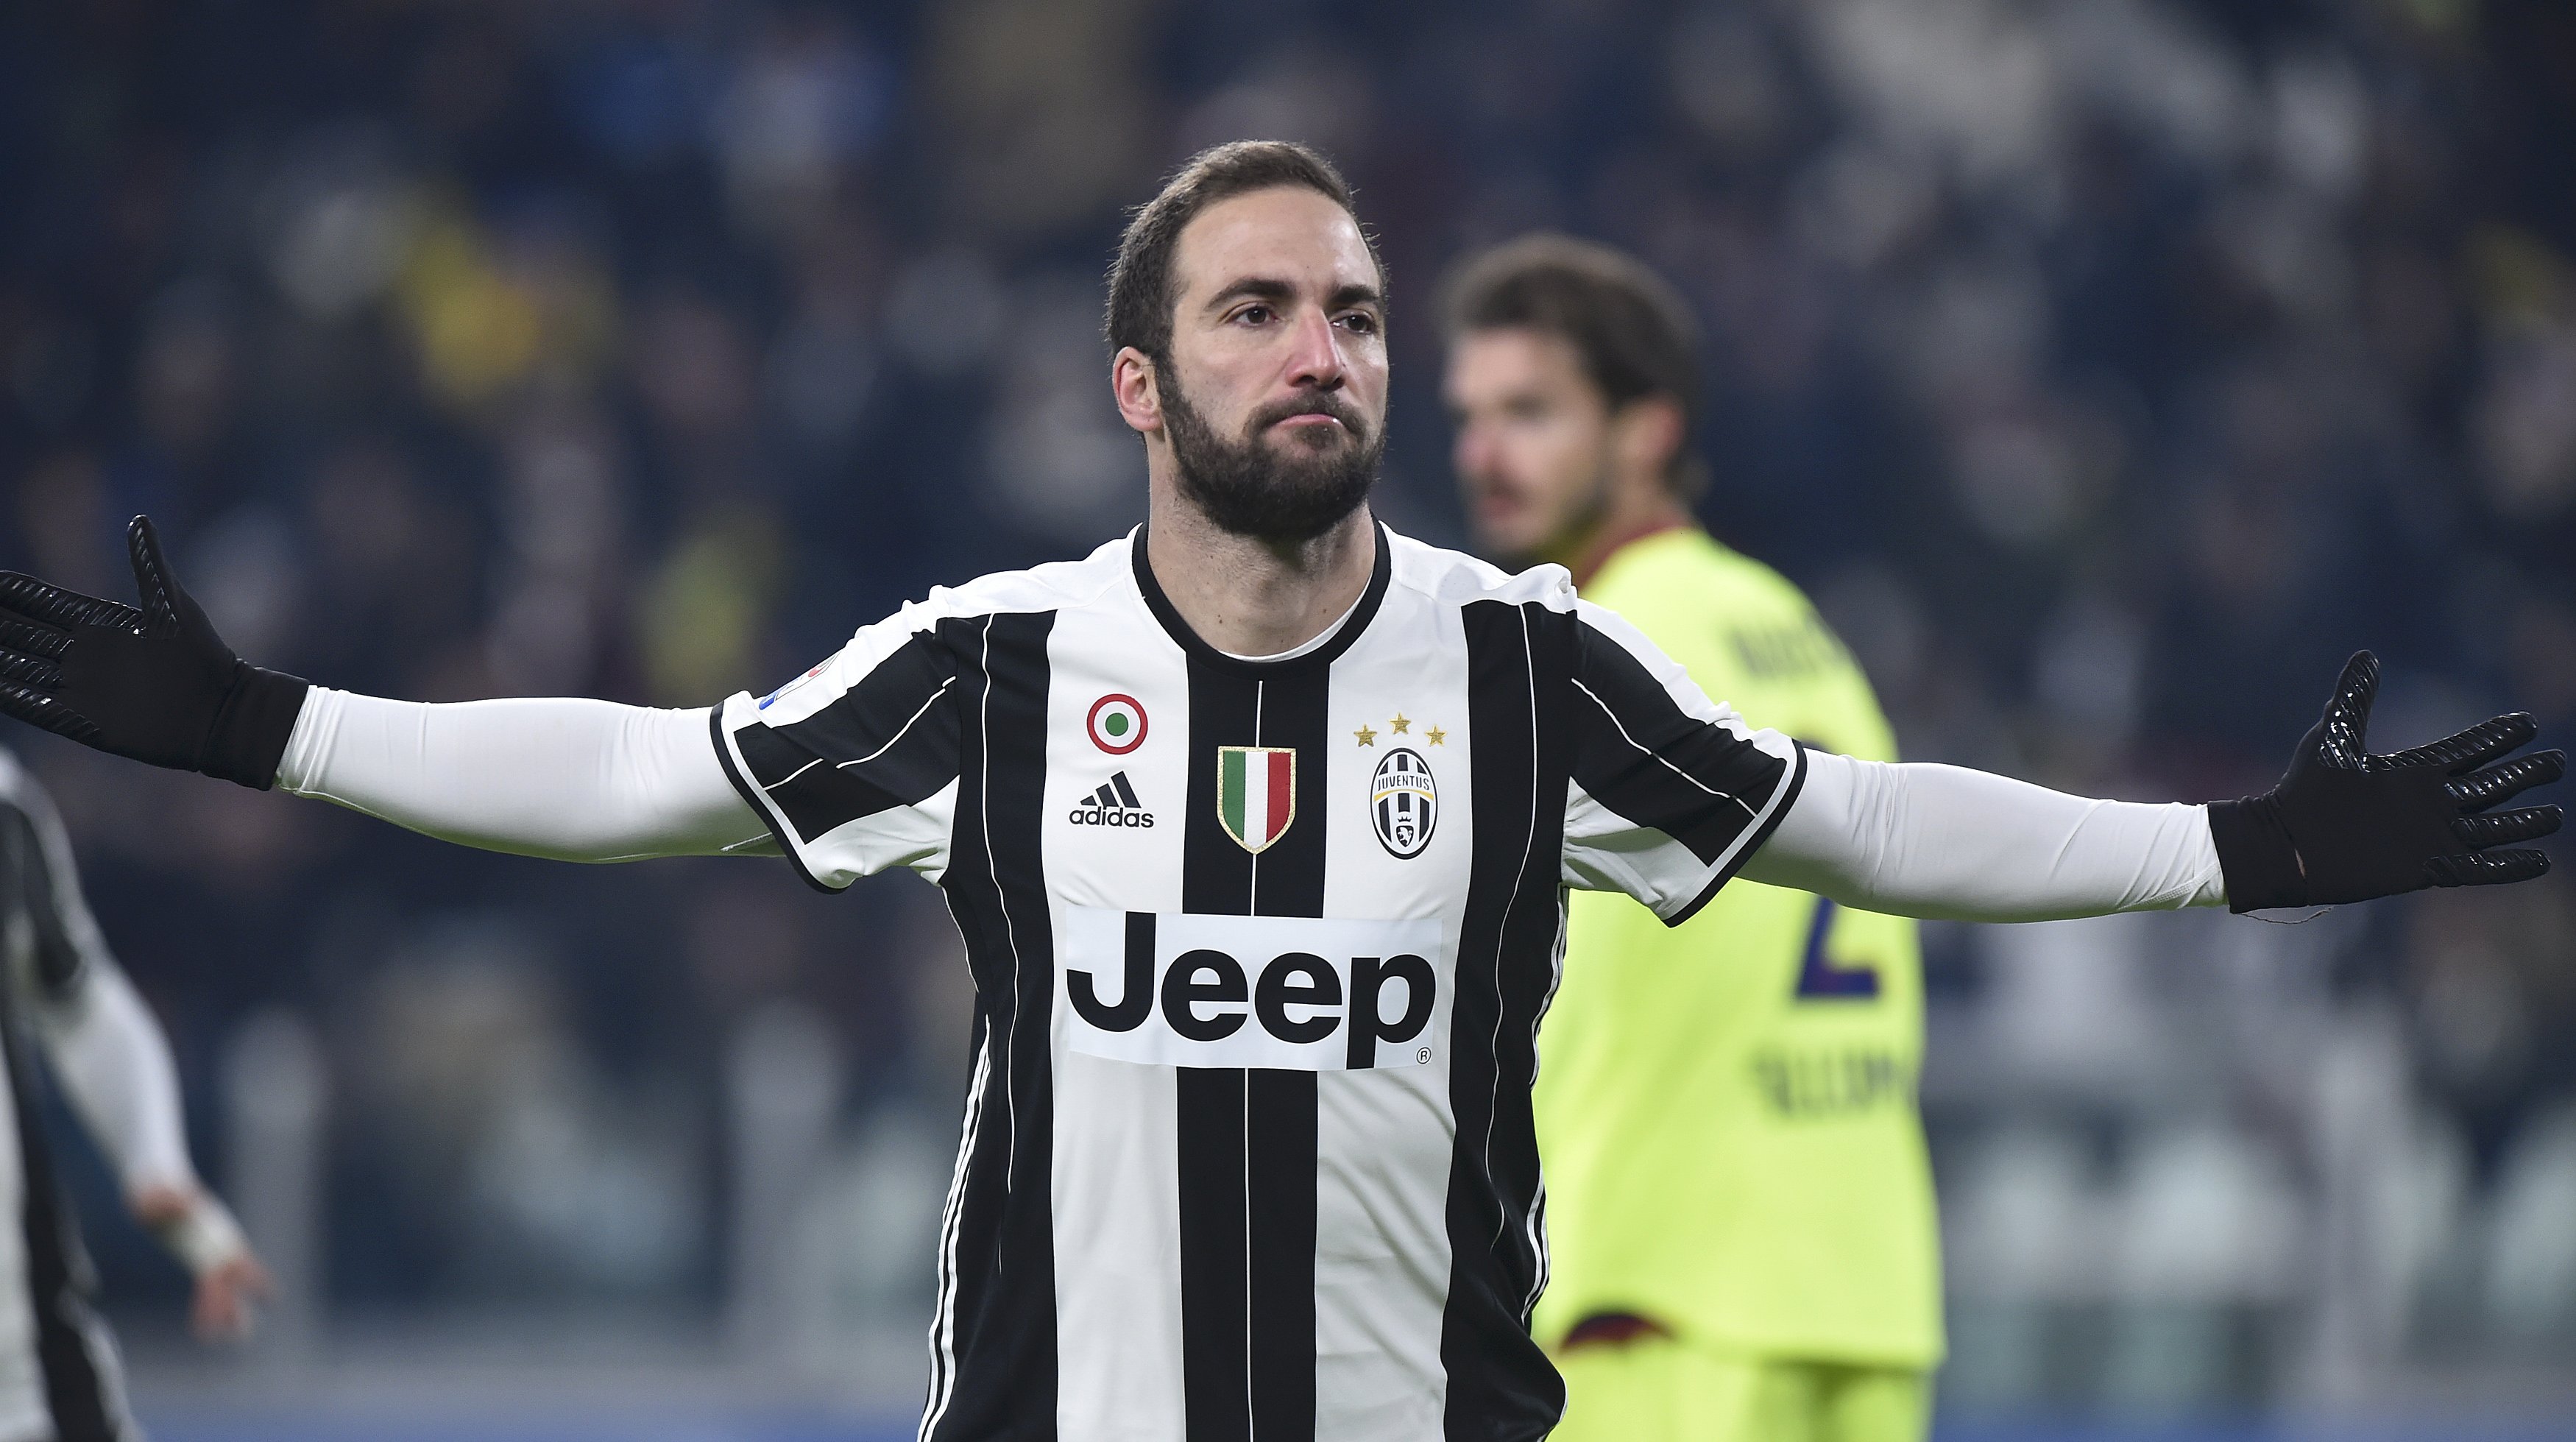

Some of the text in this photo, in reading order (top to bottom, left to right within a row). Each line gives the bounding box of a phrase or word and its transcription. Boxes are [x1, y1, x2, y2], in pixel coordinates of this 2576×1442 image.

[1378, 774, 1430, 792] JUVENTUS
[1069, 806, 1155, 829] adidas
[1066, 911, 1437, 1070] Jeep
